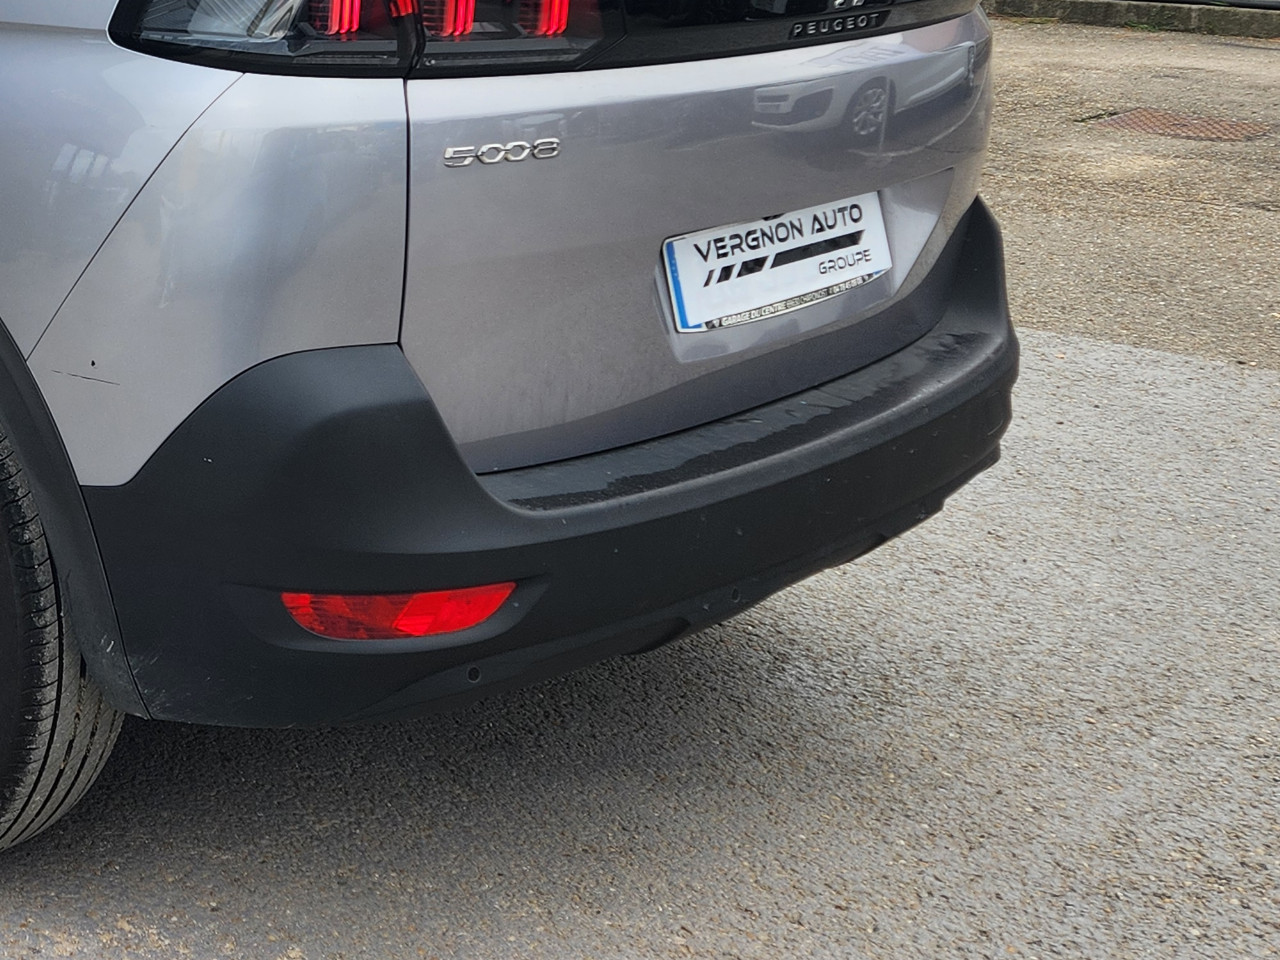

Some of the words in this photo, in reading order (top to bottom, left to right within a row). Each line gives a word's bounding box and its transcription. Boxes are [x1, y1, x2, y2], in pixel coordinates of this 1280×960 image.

[793, 13, 879, 37] PEUGEOT
[443, 138, 560, 168] 5008
[694, 218, 804, 262] VERGNON
[811, 204, 863, 235] AUTO
[818, 249, 873, 275] GROUPE
